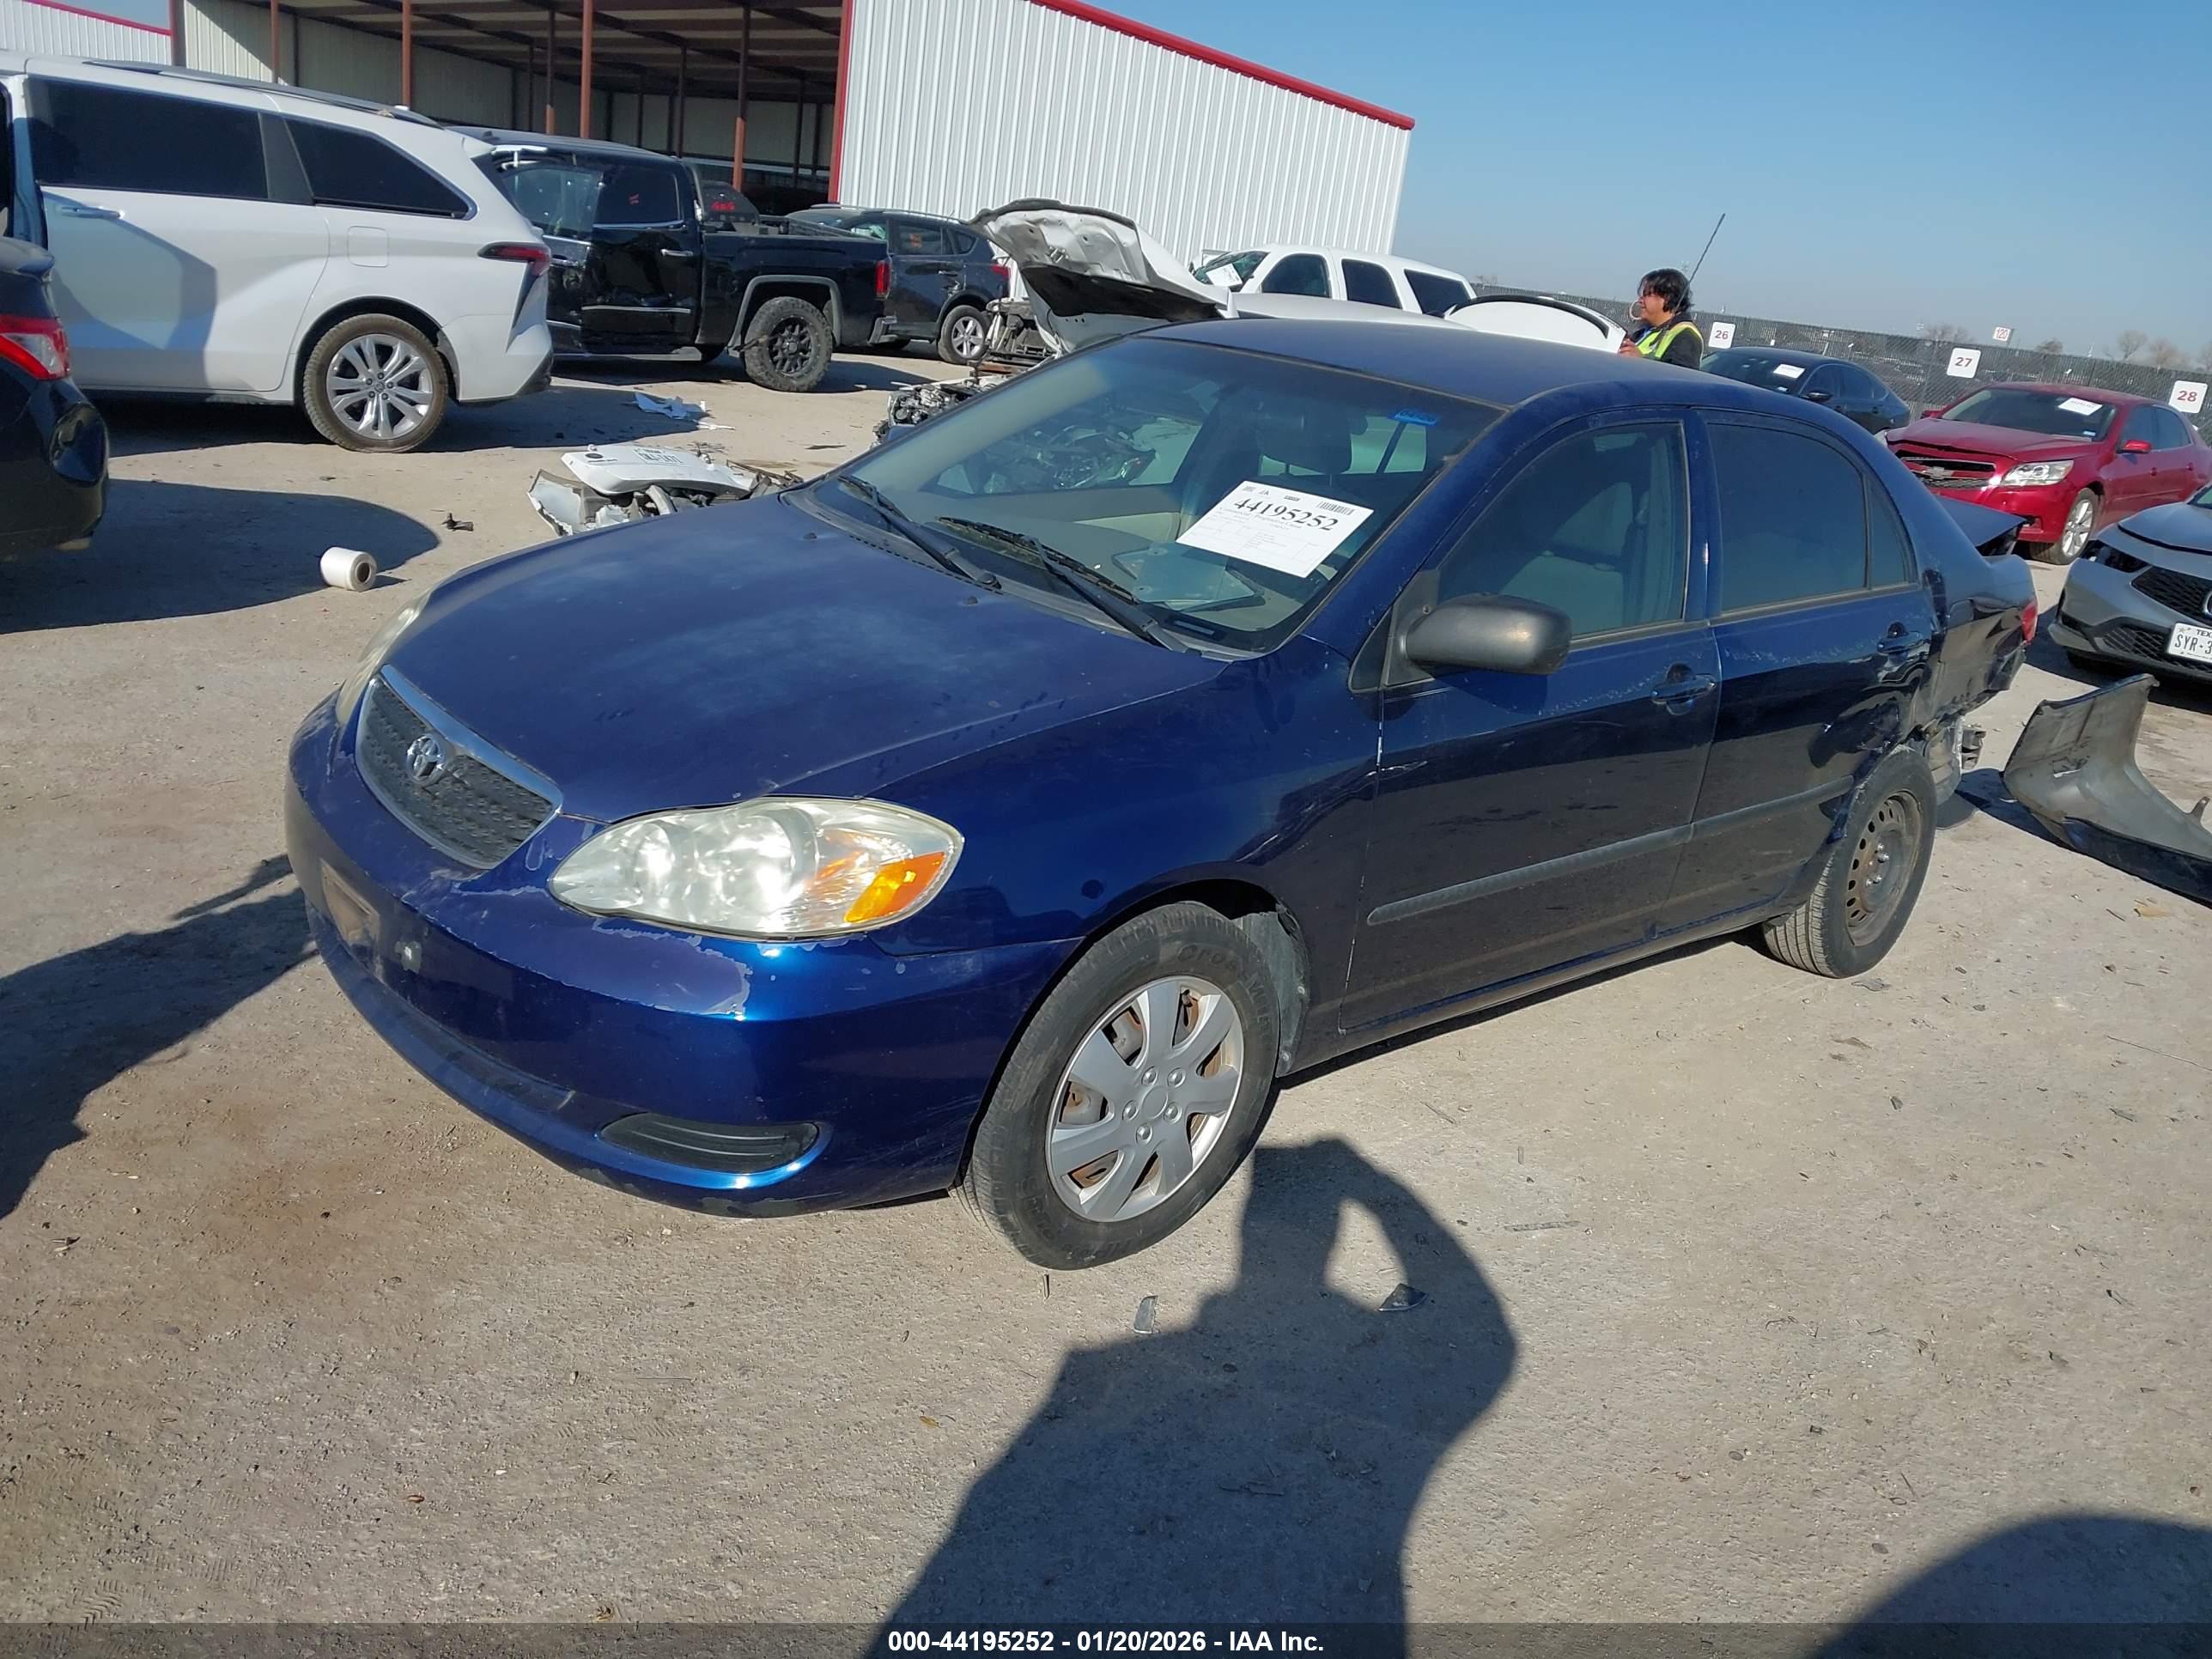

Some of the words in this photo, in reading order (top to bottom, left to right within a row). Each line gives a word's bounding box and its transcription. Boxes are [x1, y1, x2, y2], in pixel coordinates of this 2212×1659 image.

[1715, 330, 1729, 340] 26
[1954, 356, 1972, 368] 27
[2177, 390, 2197, 402] 28
[1234, 498, 1339, 531] 44195252
[2197, 629, 2212, 638] TEX
